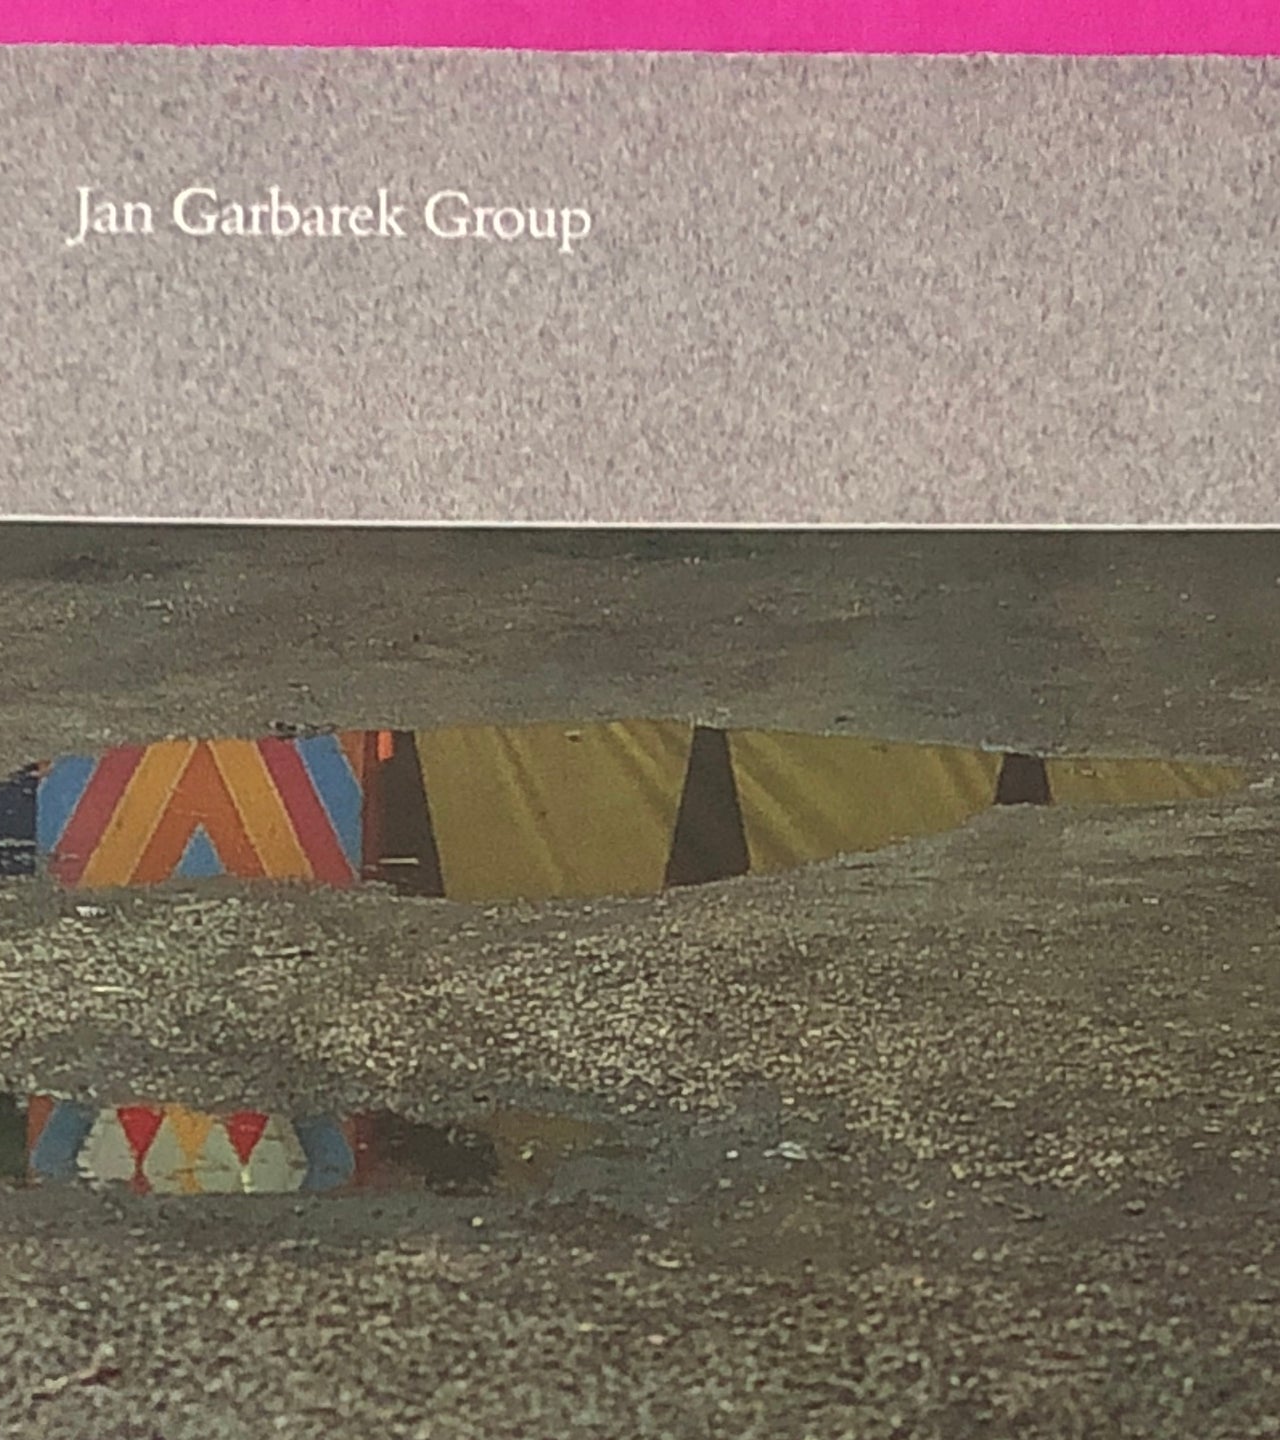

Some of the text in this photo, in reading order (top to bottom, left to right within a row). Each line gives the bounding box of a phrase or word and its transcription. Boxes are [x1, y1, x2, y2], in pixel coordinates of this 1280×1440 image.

[66, 185, 592, 254] Jan Garbarek Group
